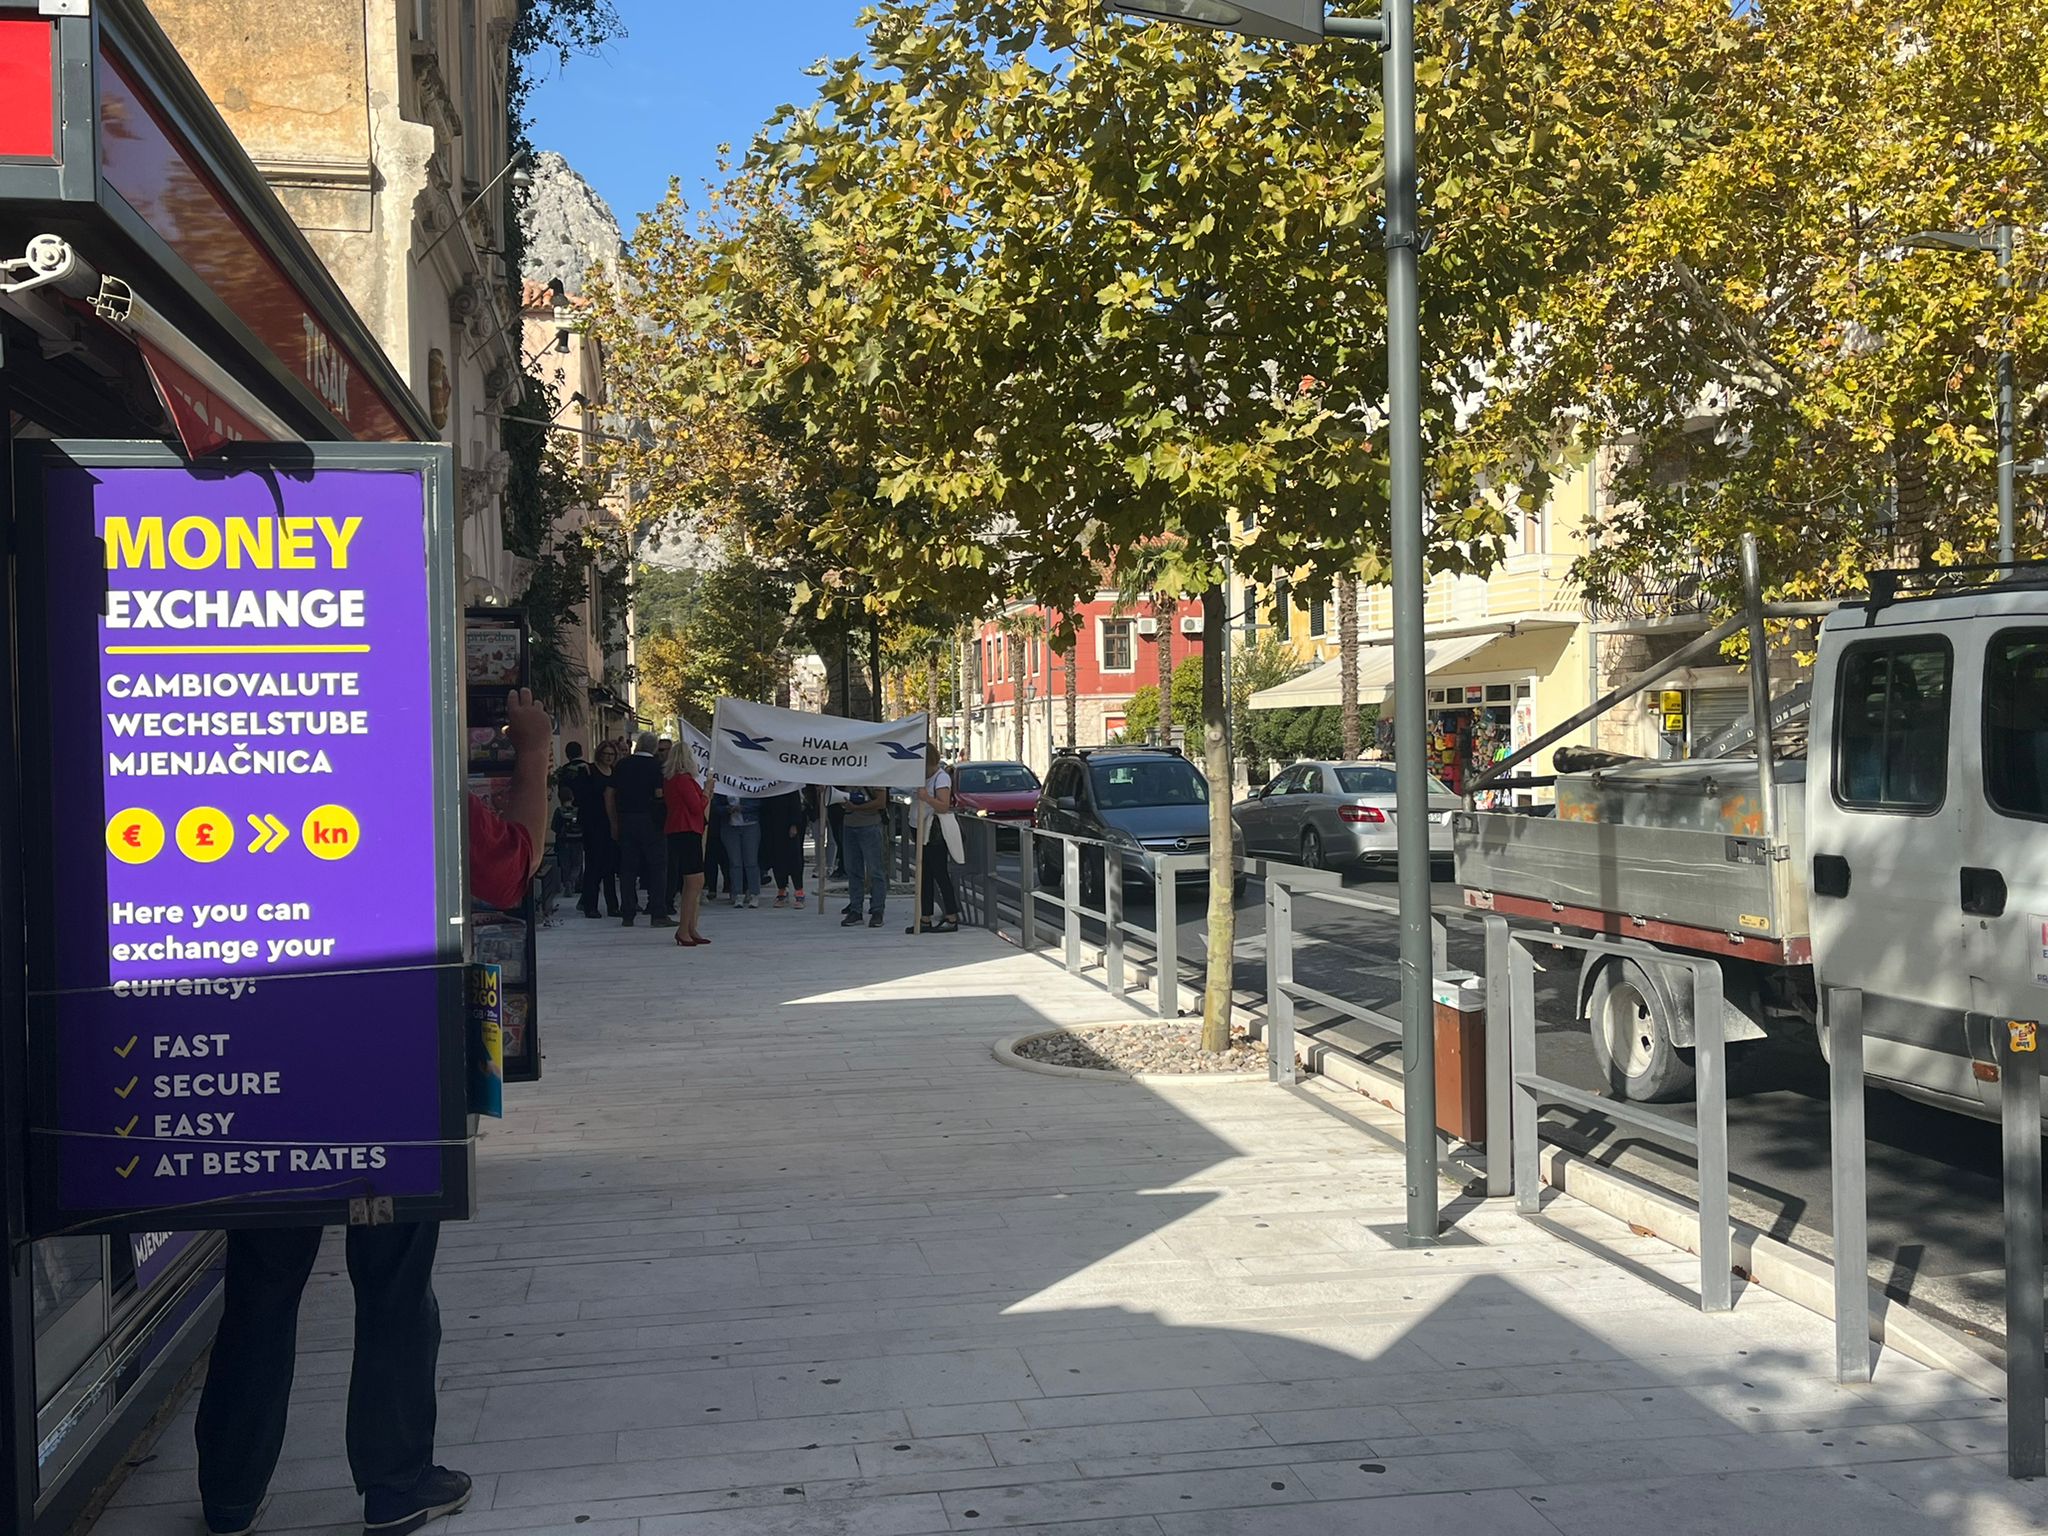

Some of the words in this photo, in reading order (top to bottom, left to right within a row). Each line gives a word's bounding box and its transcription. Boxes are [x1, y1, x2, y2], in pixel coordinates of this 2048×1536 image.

[303, 312, 349, 421] TISAK
[103, 516, 363, 570] MONEY
[105, 589, 365, 629] EXCHANGE
[106, 672, 359, 698] CAMBIOVALUTE
[107, 710, 368, 737] WECHSELSTUBE
[802, 736, 849, 751] HVALA
[109, 743, 333, 776] MJENJAČNICA
[779, 752, 827, 766] GRADE
[832, 755, 868, 767] MOJ!
[723, 774, 737, 787] ILI
[313, 822, 349, 845] kn
[111, 902, 184, 925] Here
[192, 903, 248, 928] you
[256, 900, 310, 921] can
[112, 935, 259, 964] exchange
[267, 937, 335, 962] your
[472, 969, 497, 990] SIM
[154, 1034, 230, 1058] FAST
[153, 1072, 281, 1098] SECURE
[154, 1112, 235, 1137] EASY
[154, 1154, 194, 1177] AT
[203, 1150, 280, 1175] BEST
[290, 1147, 387, 1172] RATES
